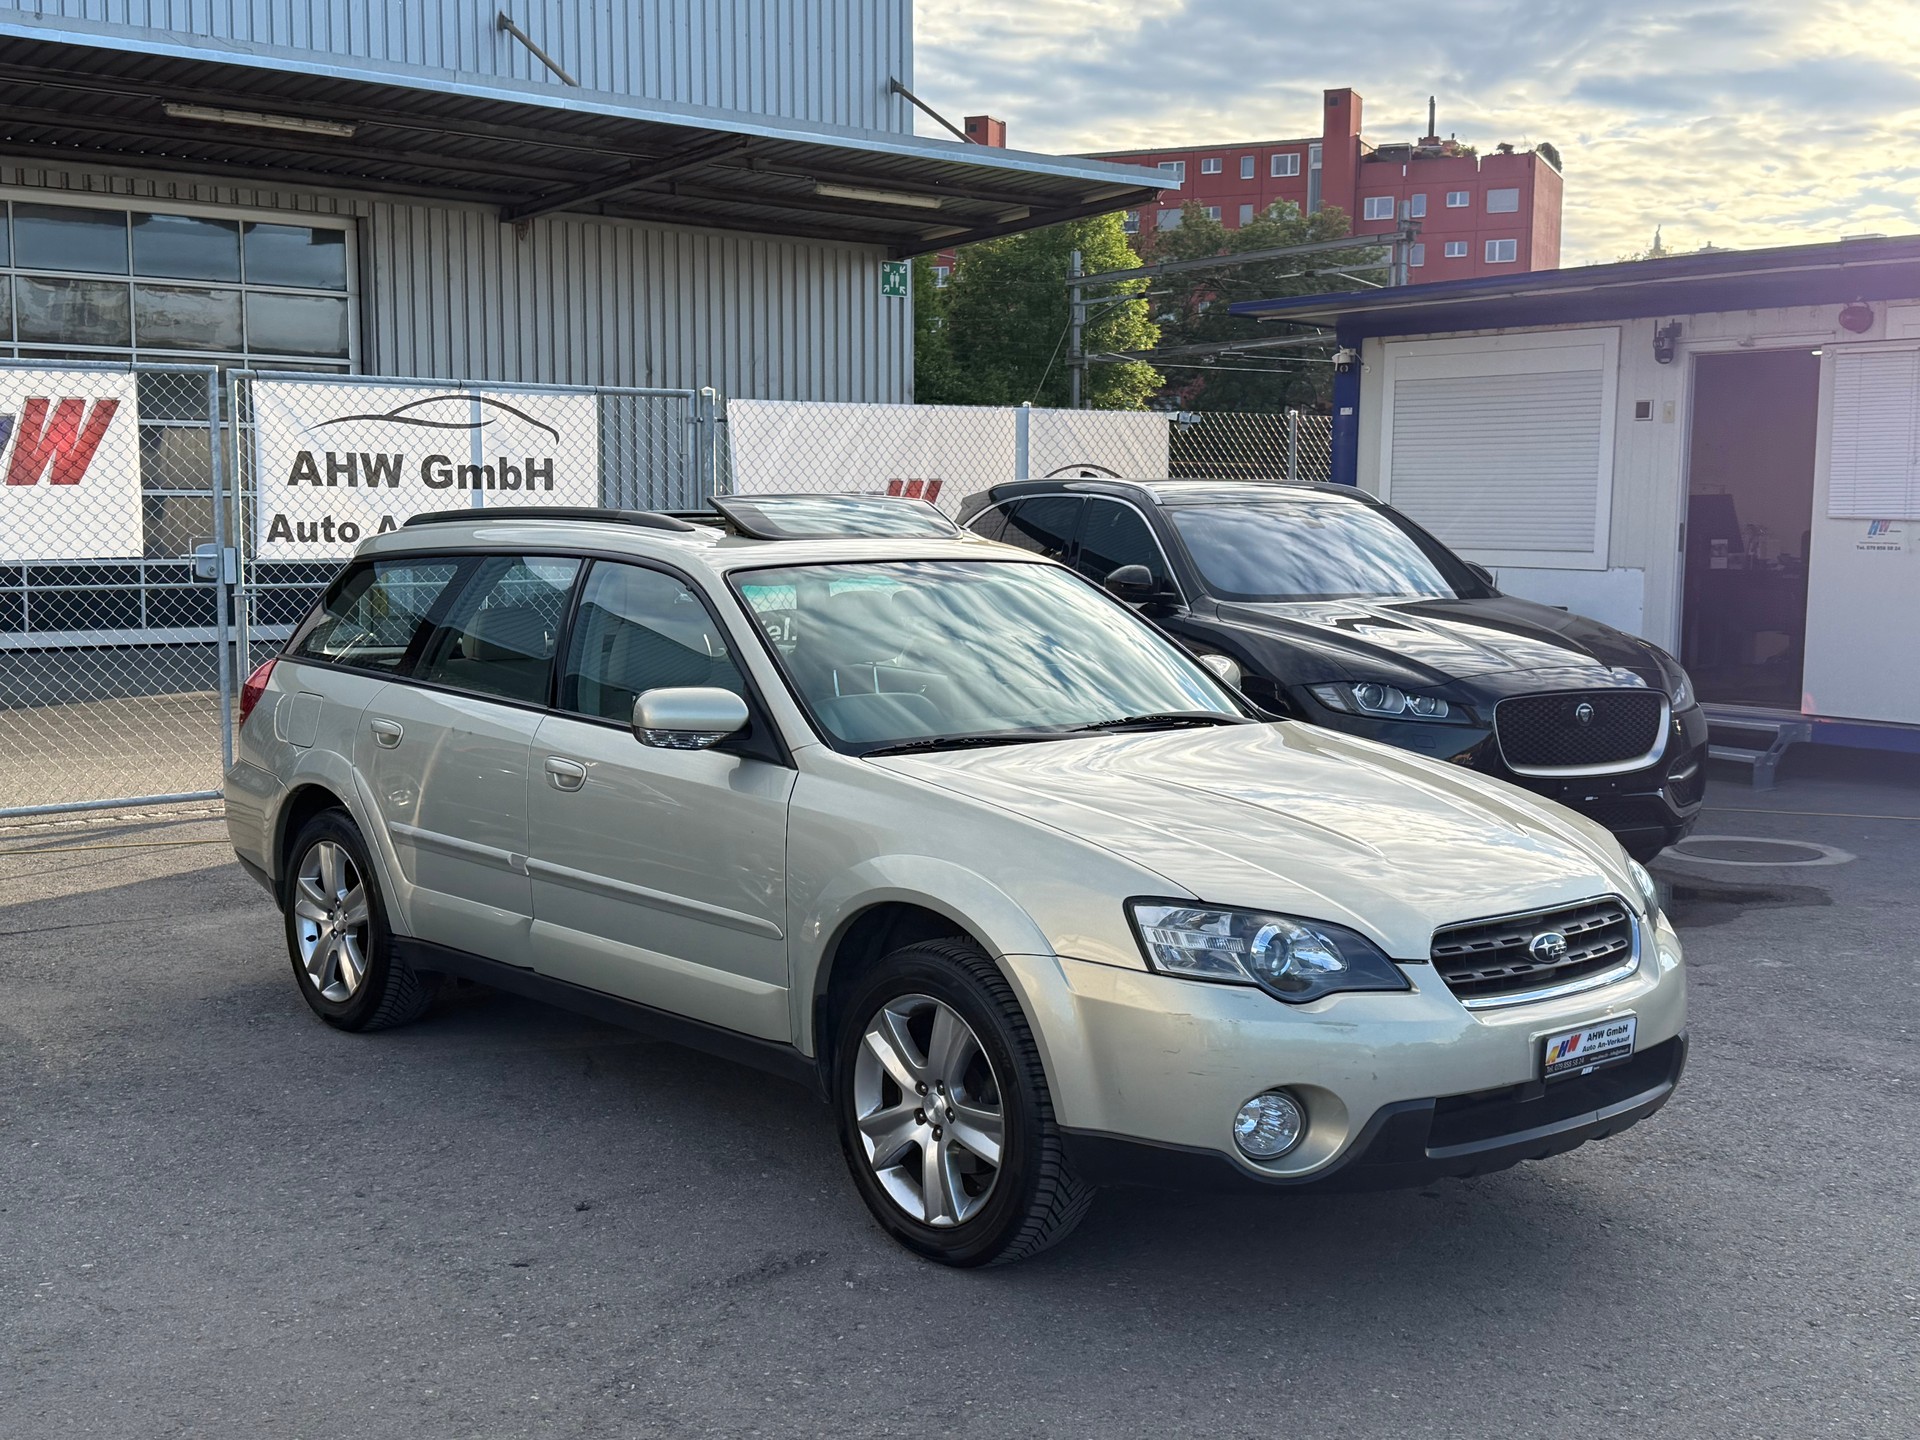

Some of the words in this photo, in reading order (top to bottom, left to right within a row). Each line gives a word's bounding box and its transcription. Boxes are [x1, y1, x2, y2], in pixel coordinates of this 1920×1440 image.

[287, 450, 404, 488] AHW
[420, 454, 554, 491] GmbH
[266, 513, 361, 543] Auto
[762, 617, 798, 641] el.
[1582, 1044, 1597, 1053] Auto
[1597, 1035, 1630, 1049] An-Verkauf
[1587, 1030, 1605, 1042] AHW
[1606, 1024, 1628, 1036] GmbH
